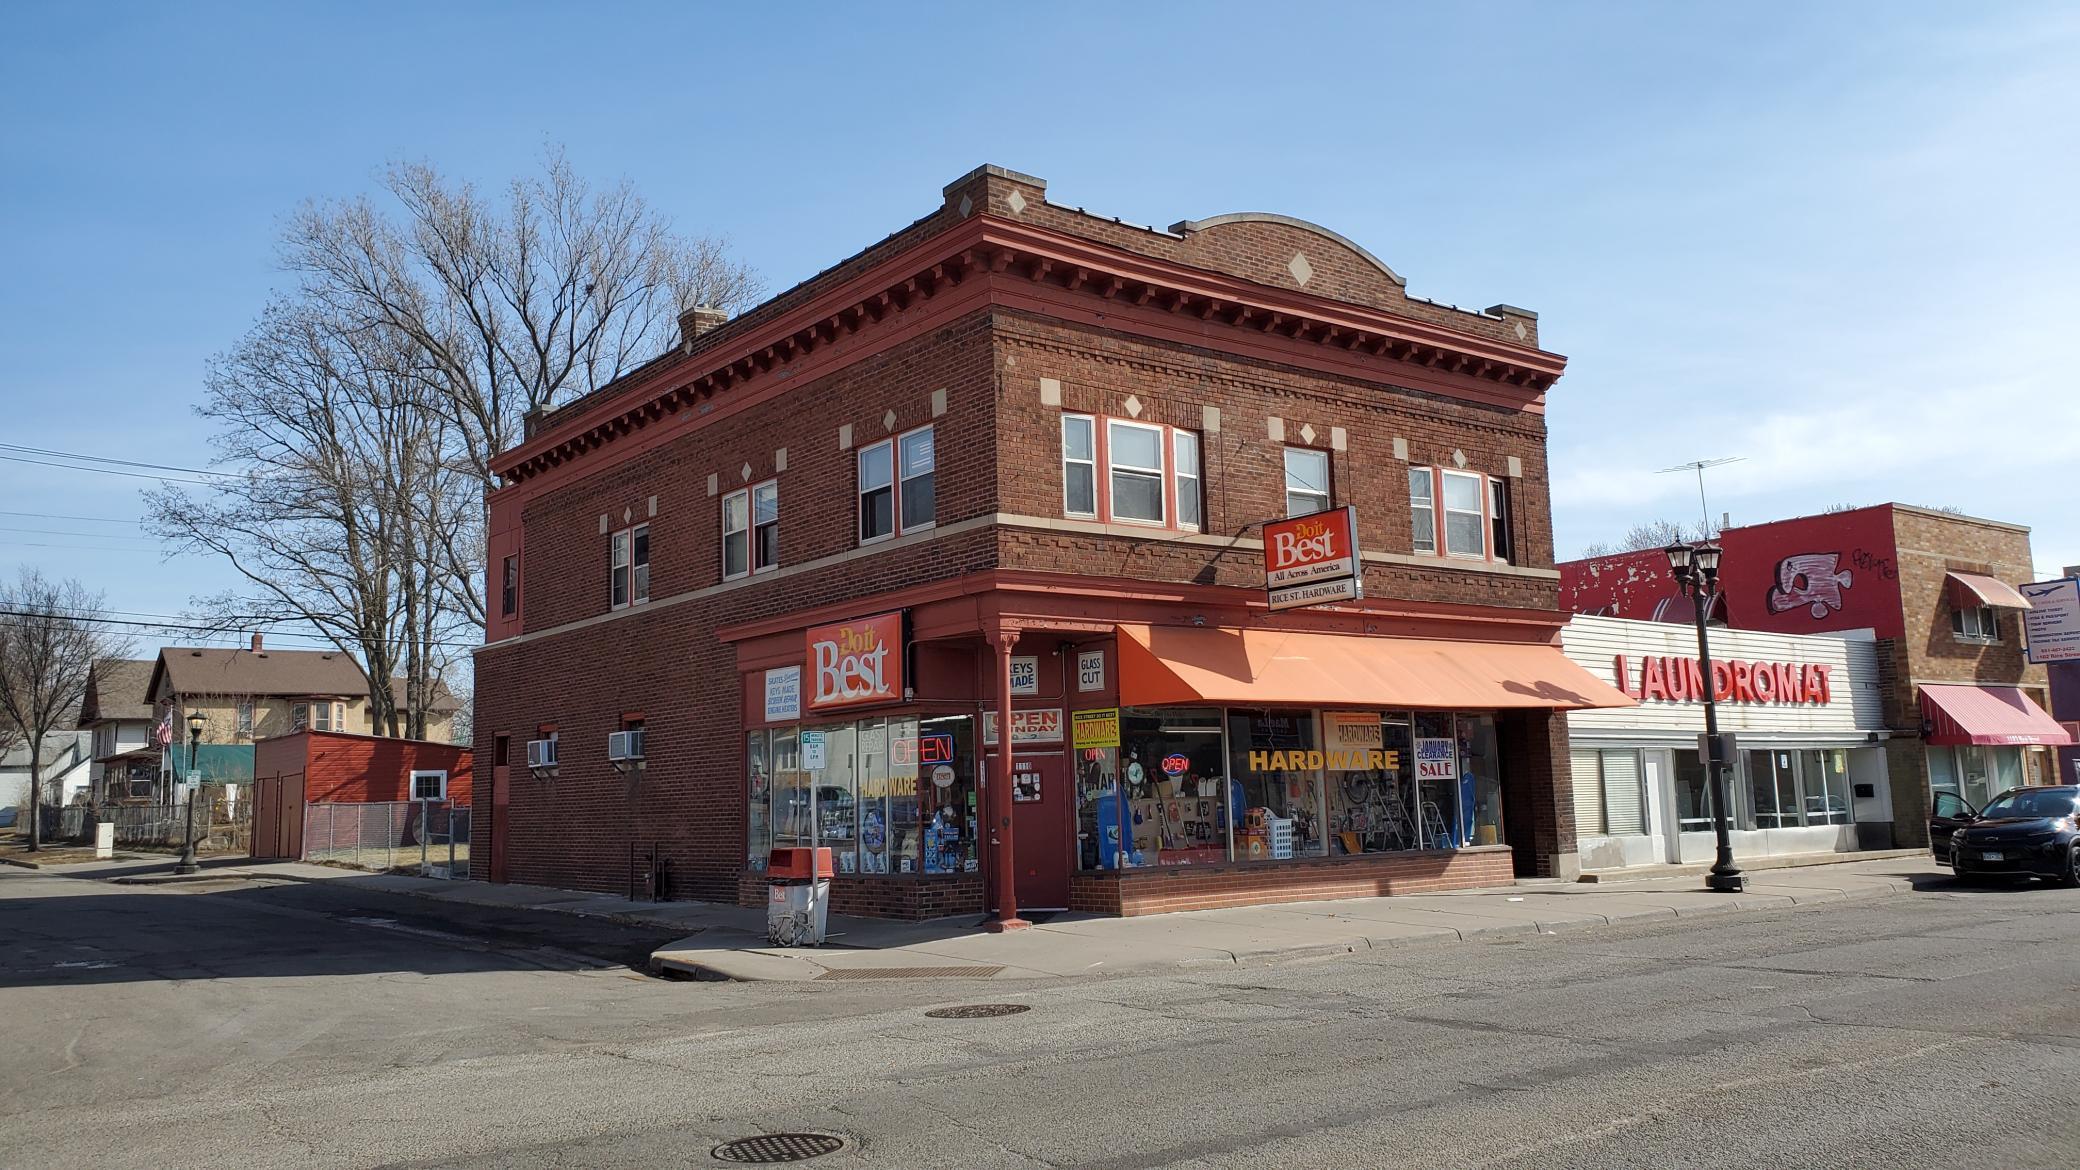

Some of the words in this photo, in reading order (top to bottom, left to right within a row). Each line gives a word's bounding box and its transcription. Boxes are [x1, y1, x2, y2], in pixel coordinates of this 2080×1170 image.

[1273, 527, 1337, 568] Best
[1274, 571, 1285, 582] All
[1287, 568, 1308, 578] Across
[1311, 562, 1341, 575] America
[1271, 590, 1289, 604] RICE
[1290, 590, 1301, 601] ST.
[1302, 583, 1347, 600] HARDWARE
[812, 639, 890, 702] Best
[1081, 657, 1101, 670] GLASS
[1081, 671, 1101, 684] CUT
[1615, 653, 1833, 705] LAUNDROMAT
[804, 733, 810, 742] 15
[991, 724, 1058, 734] SNDAY
[1075, 720, 1117, 741] HARDWARE
[1338, 724, 1381, 743] HARDWARE
[893, 736, 951, 763] OPEN
[1085, 748, 1106, 761] OPEN
[1417, 750, 1453, 760] CLEARANCE
[1420, 740, 1449, 751] JANUARY
[1161, 757, 1190, 772] OPEN
[1249, 750, 1400, 771] HARDWARE
[1420, 762, 1453, 777] SALE
[861, 775, 918, 798] HARDWARE
